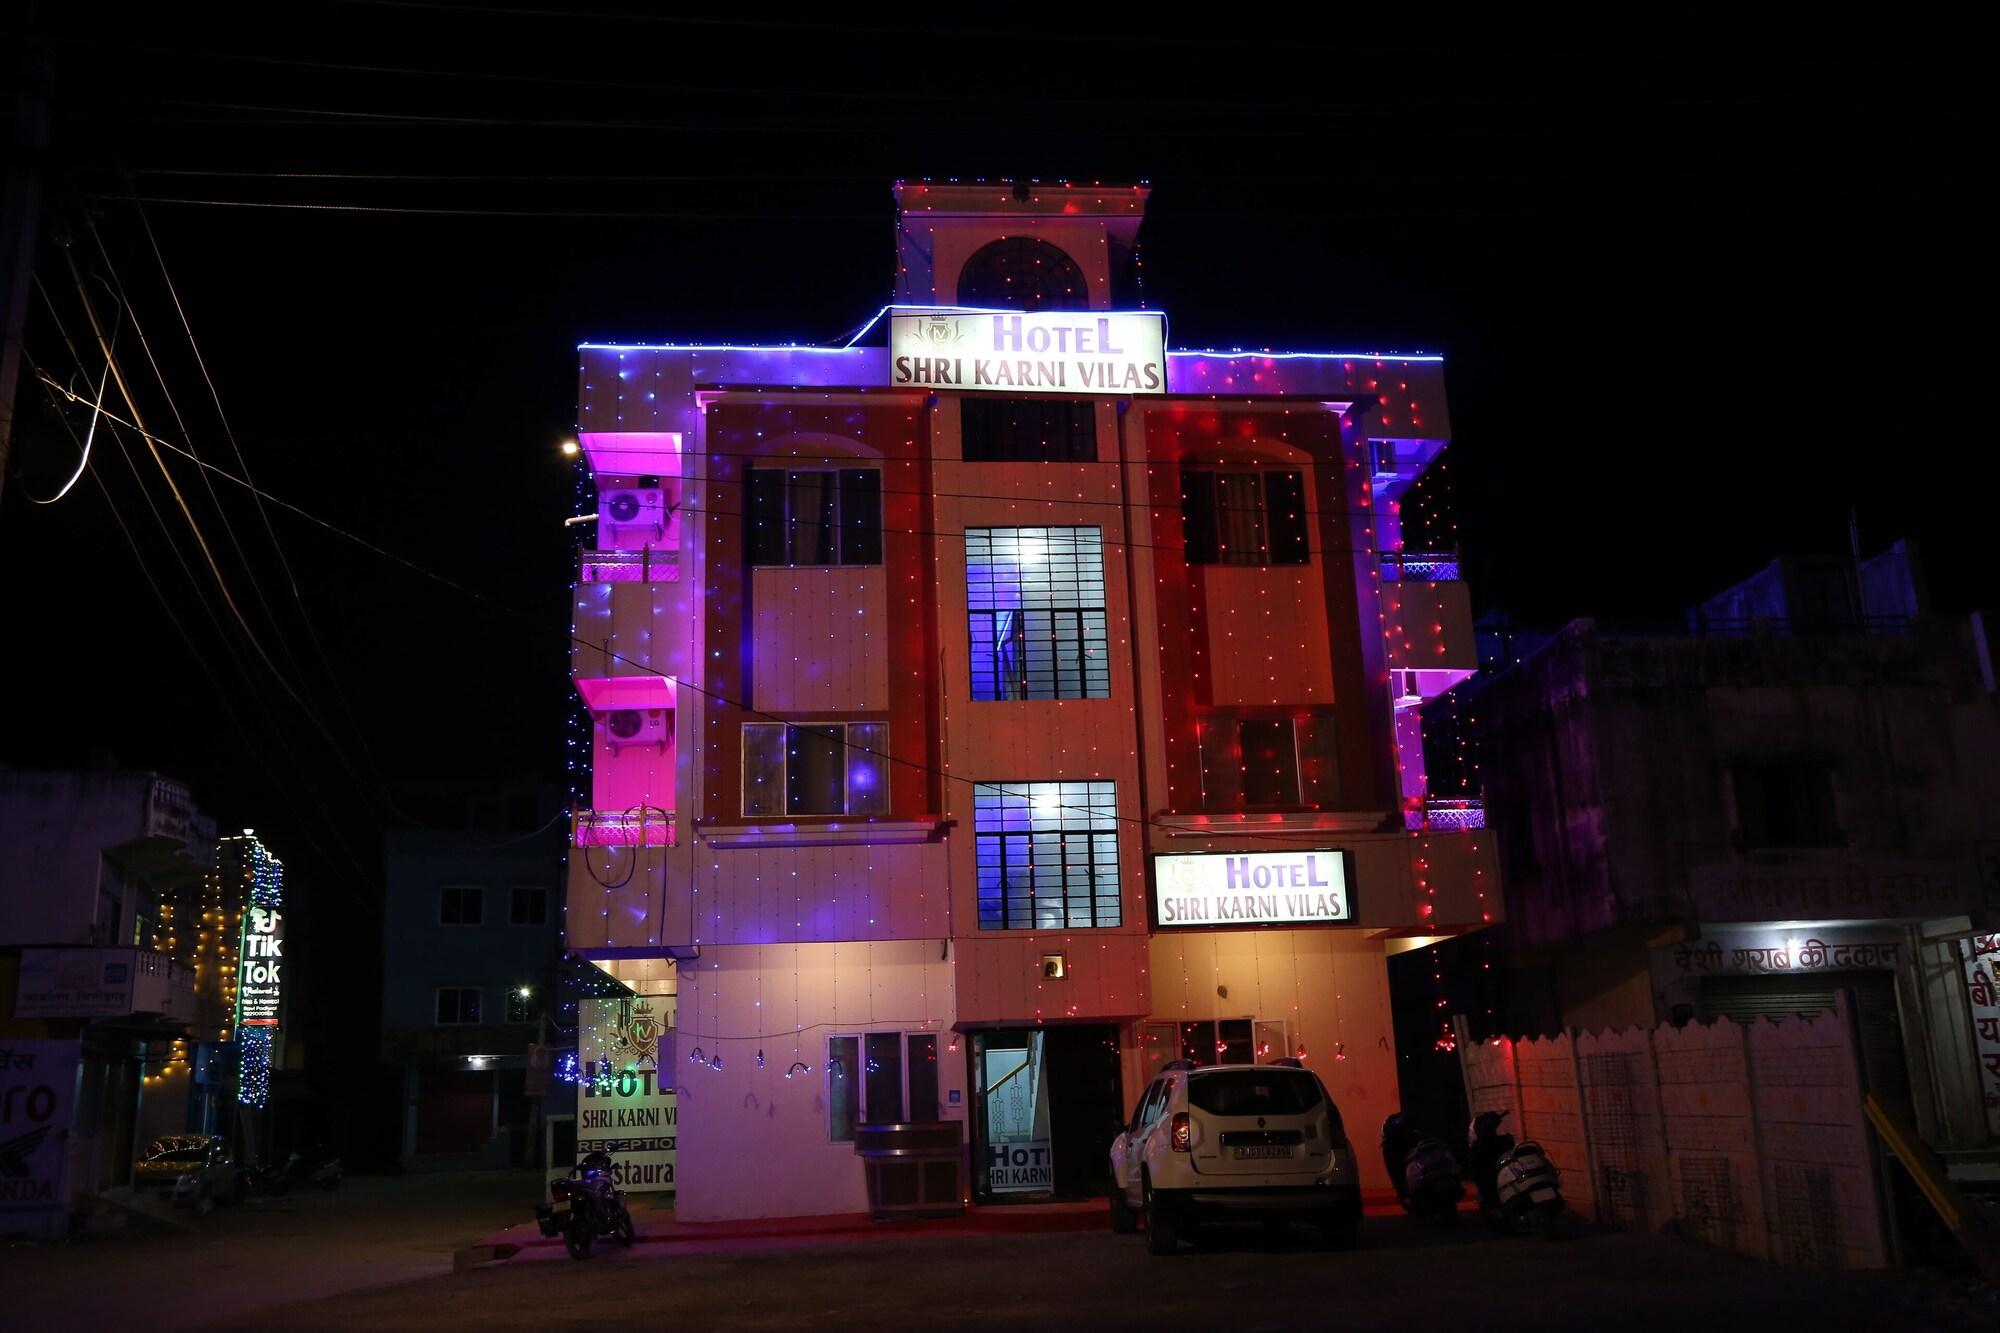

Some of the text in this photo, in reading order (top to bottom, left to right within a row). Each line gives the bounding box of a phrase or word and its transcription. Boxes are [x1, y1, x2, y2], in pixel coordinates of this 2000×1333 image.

[993, 315, 1124, 354] HOTEL
[896, 356, 1160, 390] SHRI KARNI VILAS
[1226, 855, 1328, 889] HOTEL
[1164, 893, 1341, 922] SHRI KARNI VILAS
[246, 935, 282, 957] Tik
[1798, 938, 1830, 970] की
[243, 960, 280, 983] Tok
[585, 1061, 677, 1098] HOT
[582, 1109, 613, 1129] SHRI
[618, 1107, 659, 1127] KARNI
[1012, 1167, 1052, 1184] KARNI
